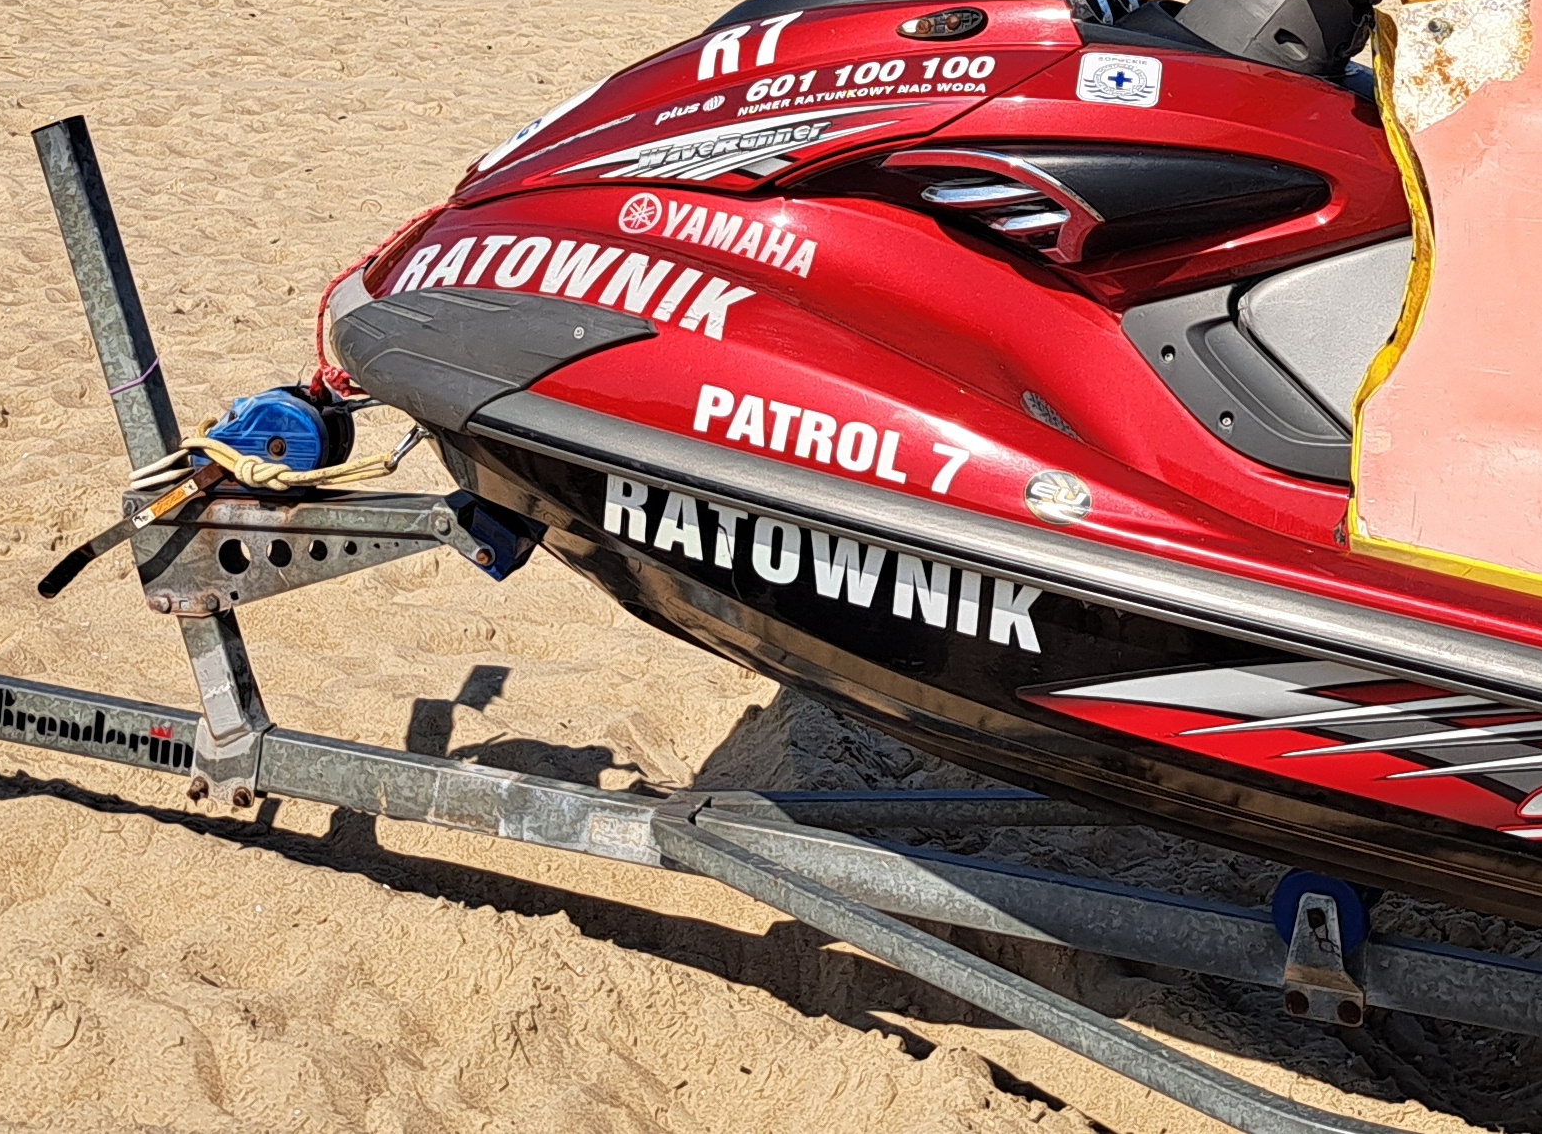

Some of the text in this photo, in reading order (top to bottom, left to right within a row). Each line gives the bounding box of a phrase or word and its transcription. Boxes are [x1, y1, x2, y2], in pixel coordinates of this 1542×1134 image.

[737, 98, 792, 117] NUMER
[795, 85, 895, 106] RATUNKOWY
[896, 83, 932, 94] NAD
[745, 56, 996, 103] 601 100 100
[638, 120, 833, 170] WaveRunner
[654, 103, 701, 126] plus
[662, 200, 819, 279] YAMAHA
[390, 234, 757, 341] RATOWNIK
[693, 383, 969, 496] PATROL 7
[603, 473, 1046, 654] RATOWNIK
